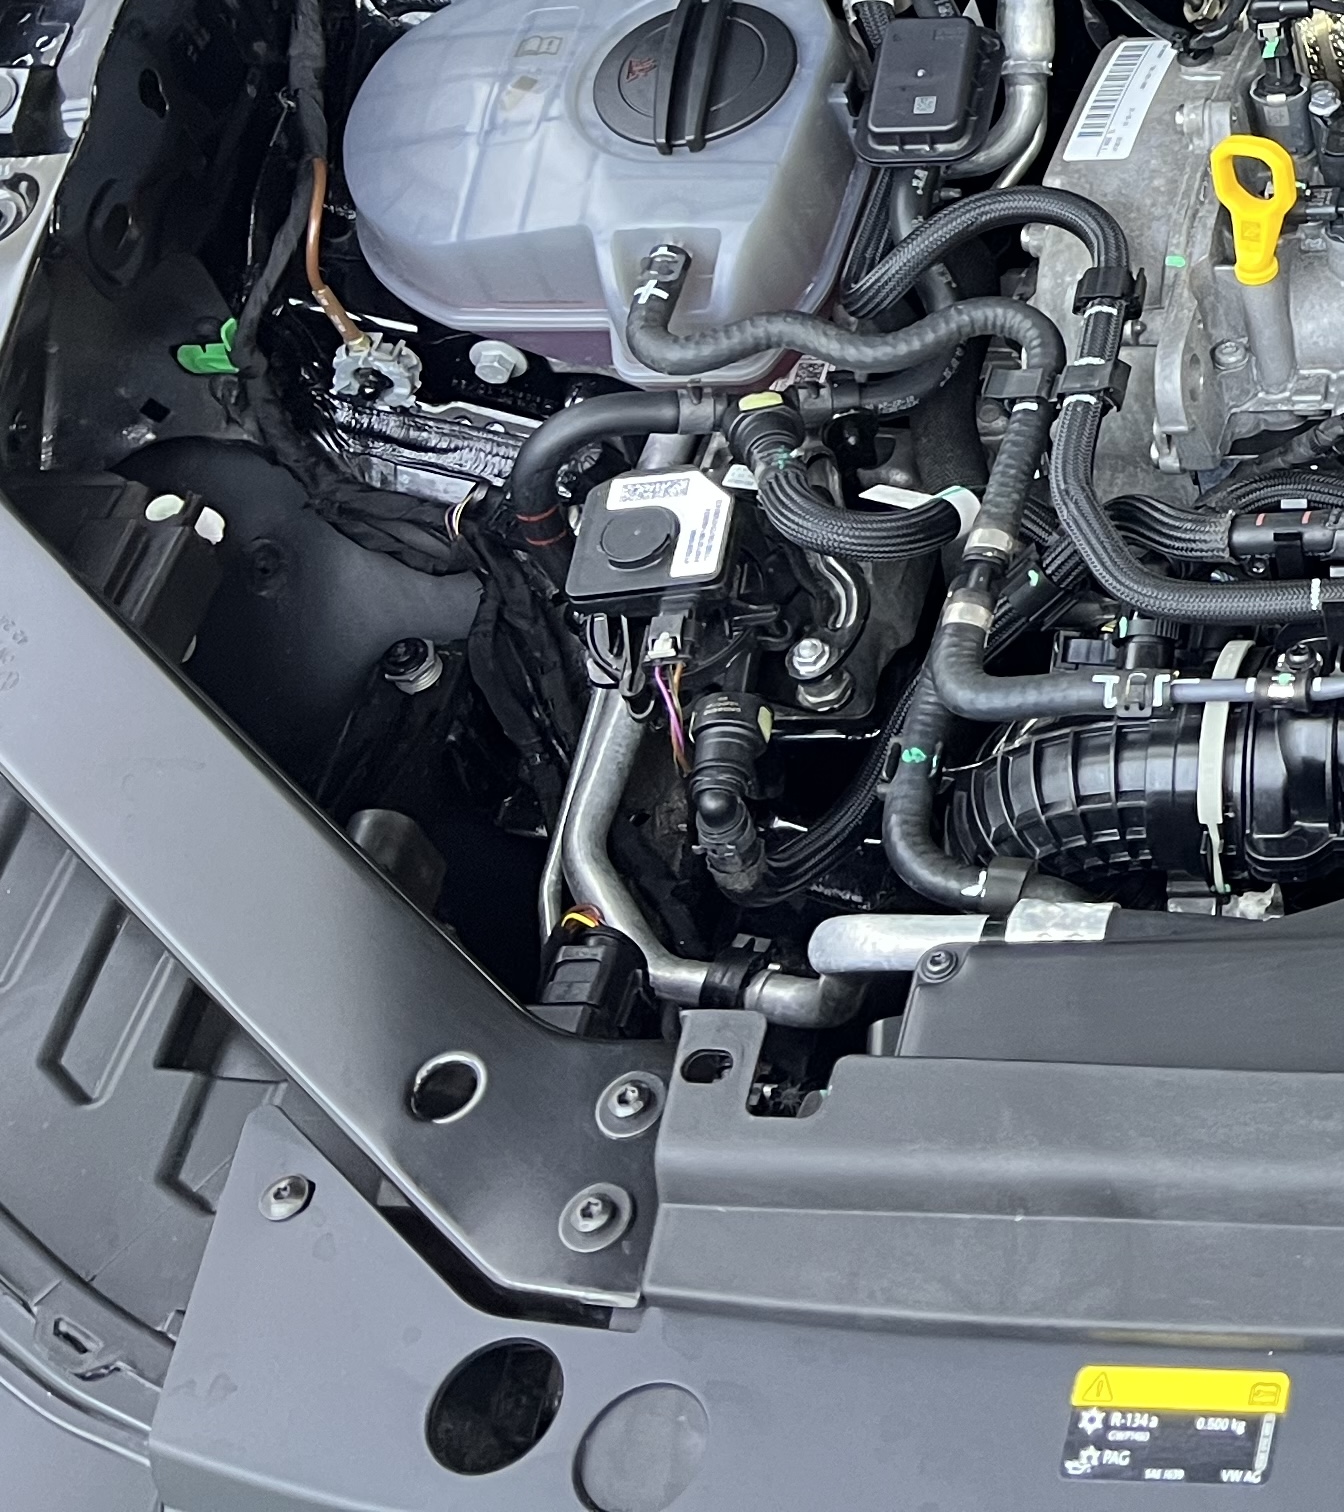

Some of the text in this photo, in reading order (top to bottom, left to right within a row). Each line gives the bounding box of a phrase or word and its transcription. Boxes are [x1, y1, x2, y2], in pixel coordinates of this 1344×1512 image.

[1230, 1418, 1247, 1436] kg
[1103, 1450, 1131, 1466] PAG
[1220, 1468, 1262, 1485] VW AG
